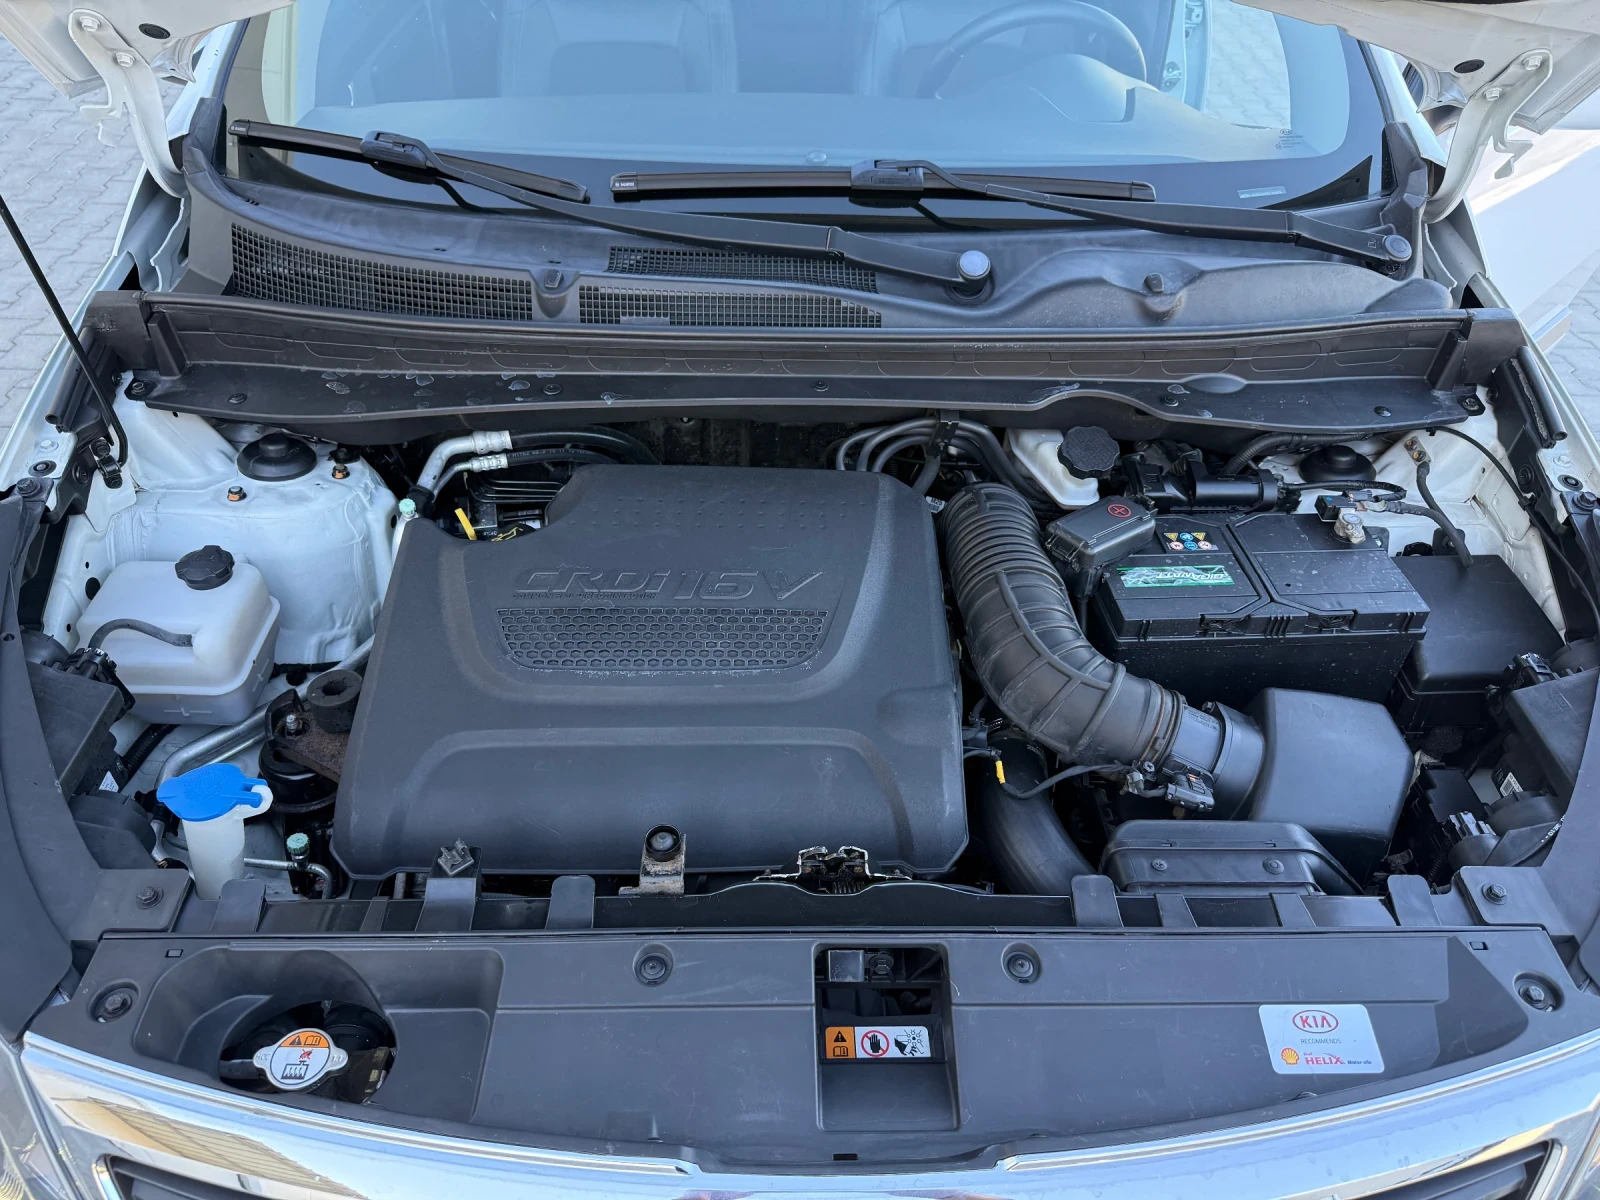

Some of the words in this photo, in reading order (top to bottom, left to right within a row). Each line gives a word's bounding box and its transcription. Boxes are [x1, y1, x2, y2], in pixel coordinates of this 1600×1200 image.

[1156, 571, 1224, 580] GIGAWATT
[1299, 1015, 1332, 1028] KIA
[1305, 1056, 1345, 1065] HELIX
